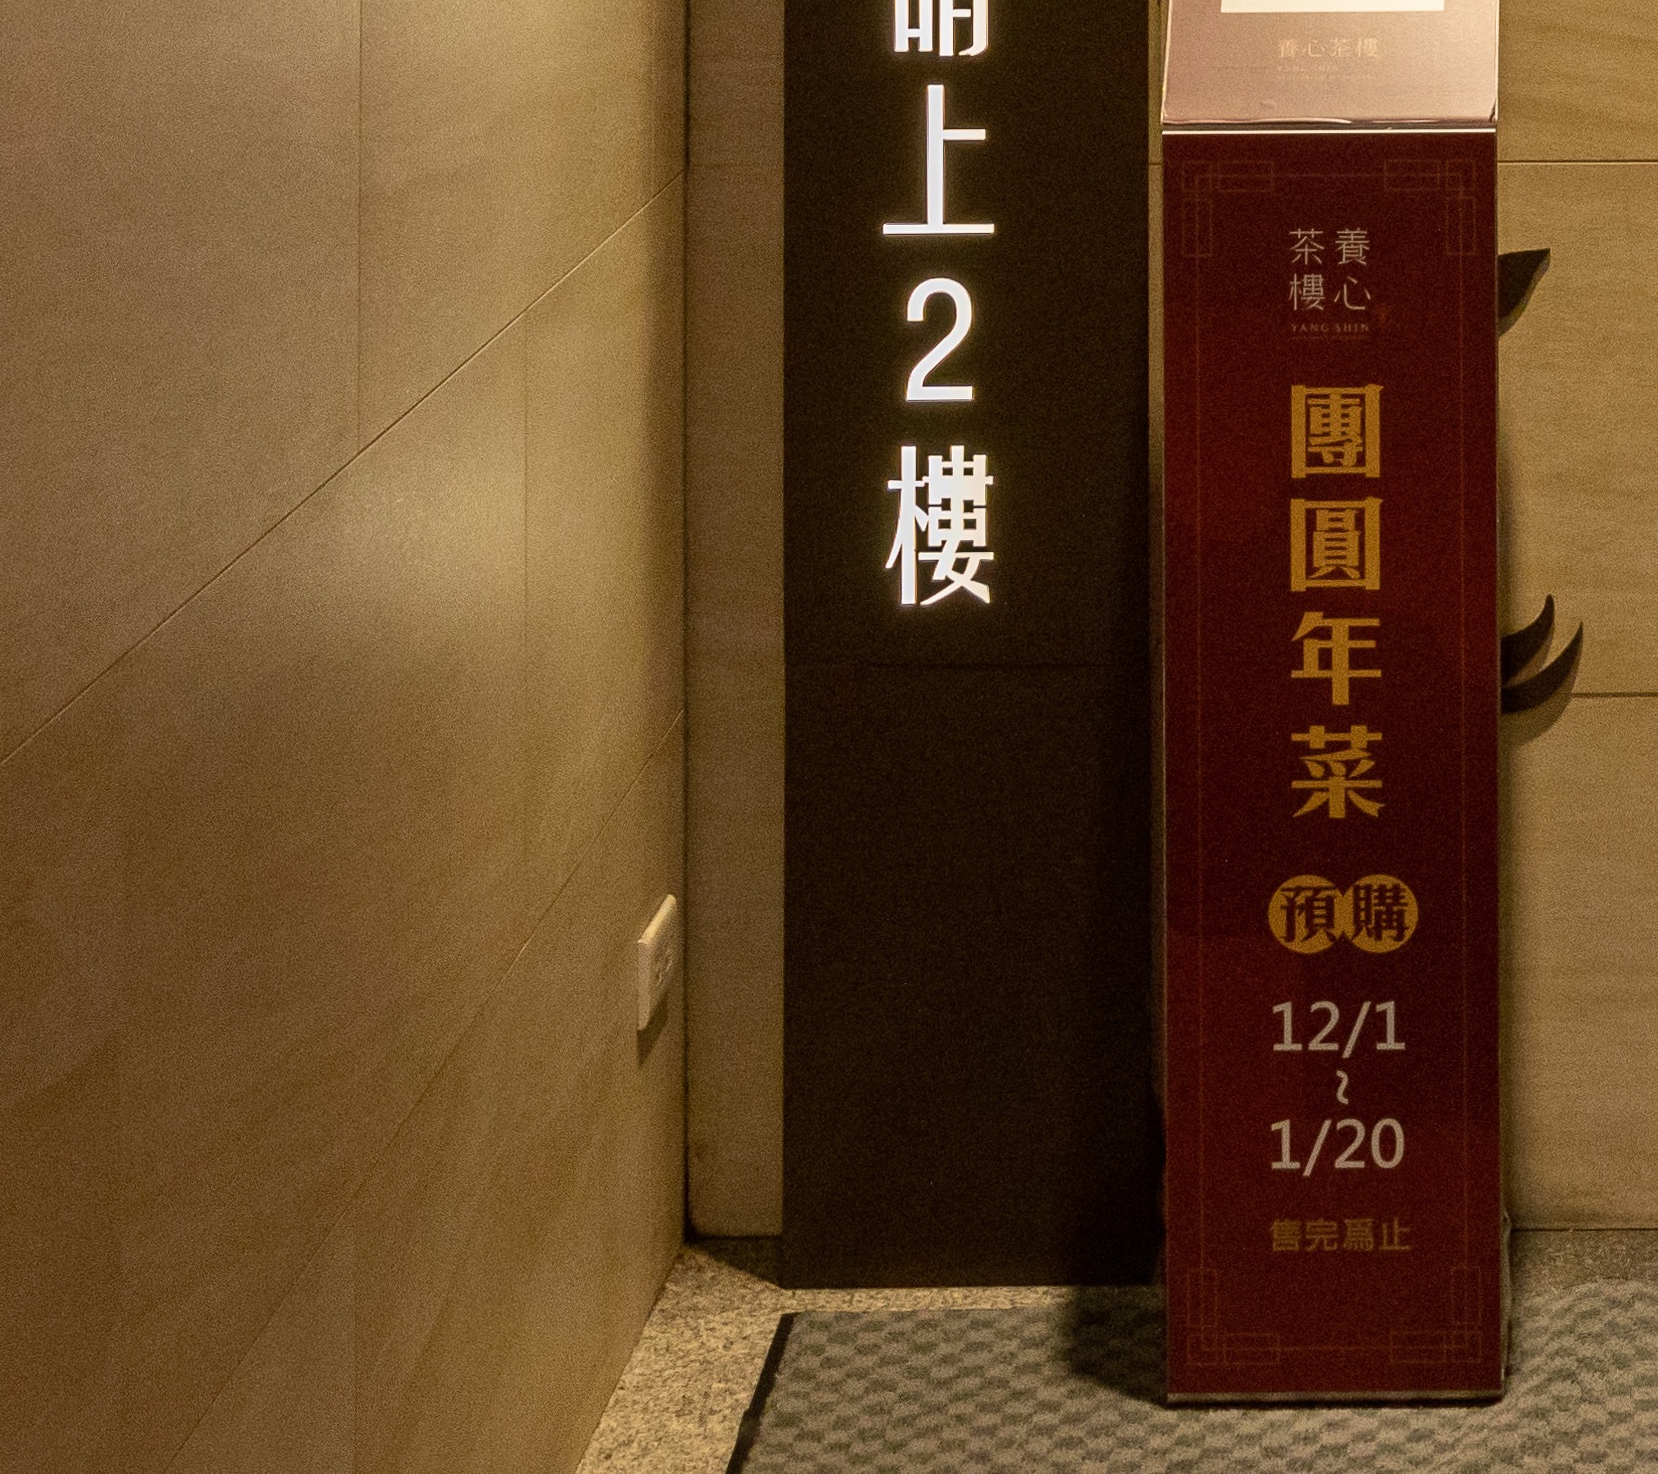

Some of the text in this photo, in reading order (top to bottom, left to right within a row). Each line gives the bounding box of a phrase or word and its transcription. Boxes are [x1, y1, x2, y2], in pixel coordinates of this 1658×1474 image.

[1288, 228, 1325, 311] 茶樓
[1333, 227, 1372, 311] 養心
[1290, 323, 1369, 332] YANG SHIN
[1290, 383, 1385, 819] 團圓年菜
[1280, 882, 1409, 942] 預購
[1271, 1000, 1406, 1059] 12/1
[1269, 1117, 1406, 1177] 1/20
